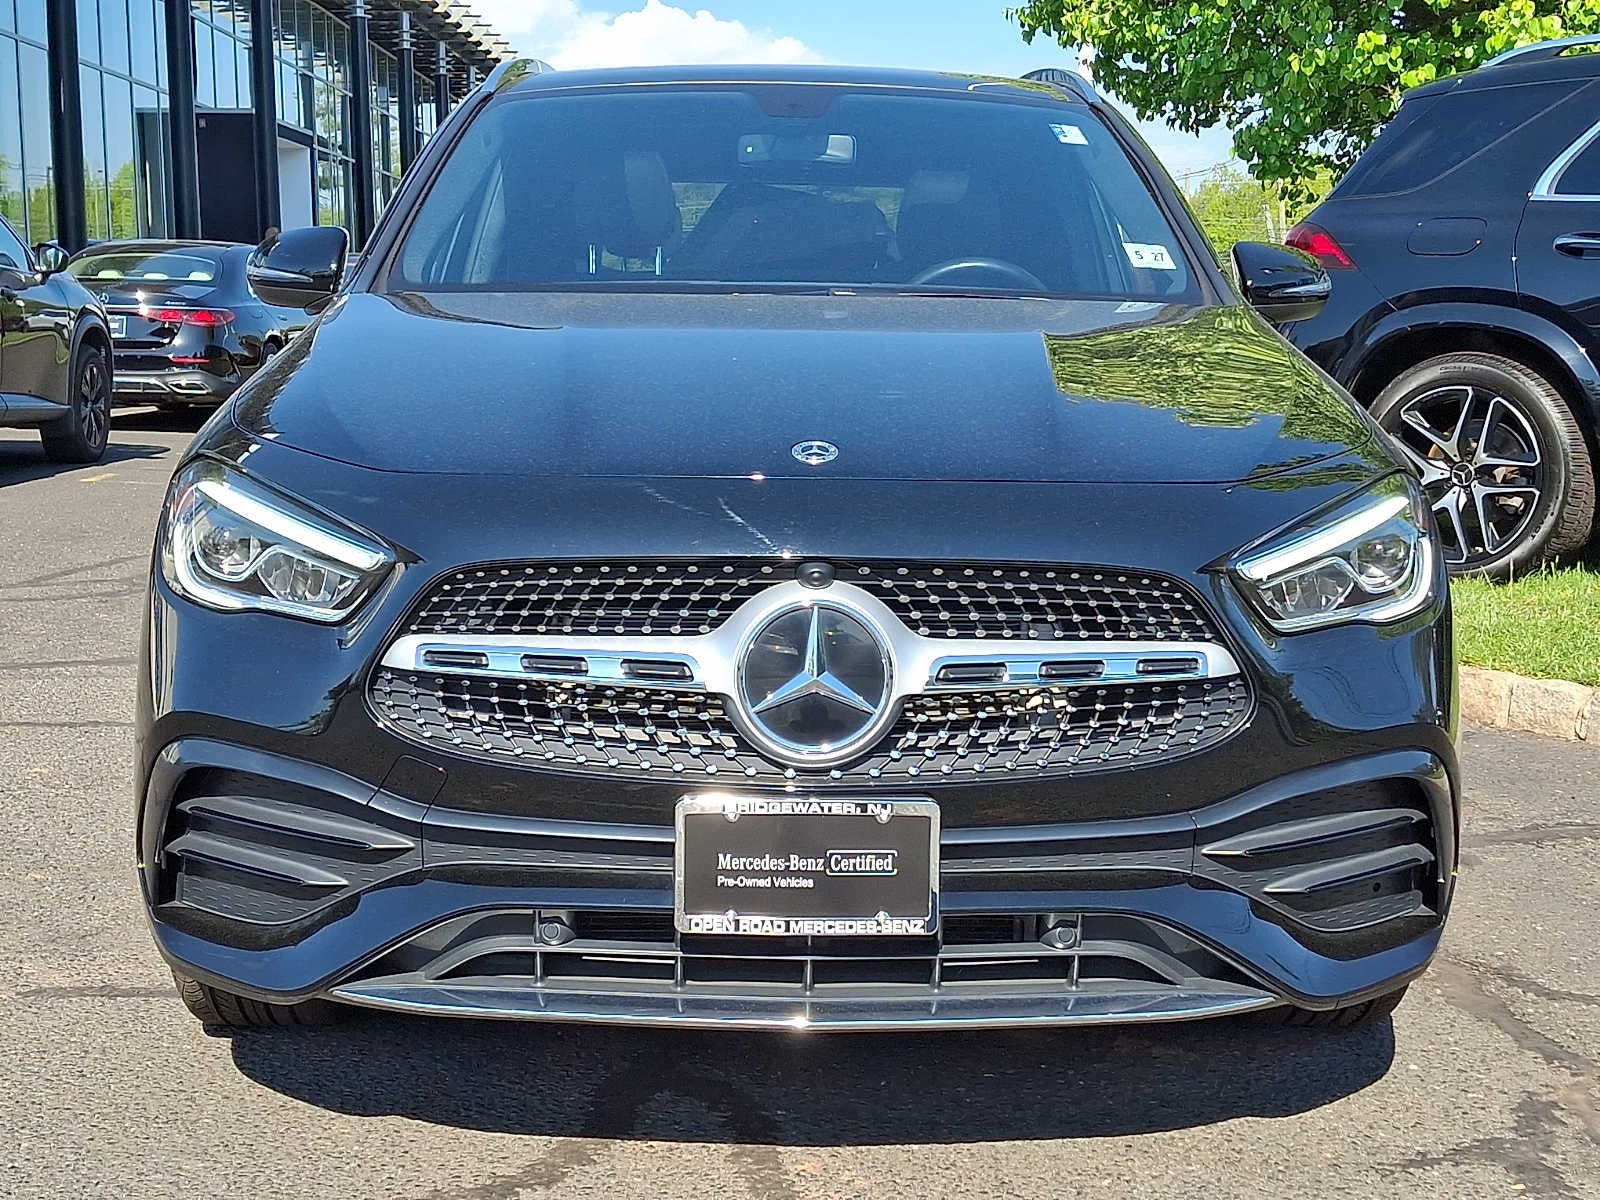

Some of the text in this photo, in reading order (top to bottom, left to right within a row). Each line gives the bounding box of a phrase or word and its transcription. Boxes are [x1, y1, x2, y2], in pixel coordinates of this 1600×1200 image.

[1134, 250, 1144, 260] 5
[717, 853, 893, 872] Mercedes-Benz Certified
[717, 876, 814, 888] Pre-Owned Vehicles
[690, 918, 925, 934] OPEN ROAD MERCEDES-BENZ
